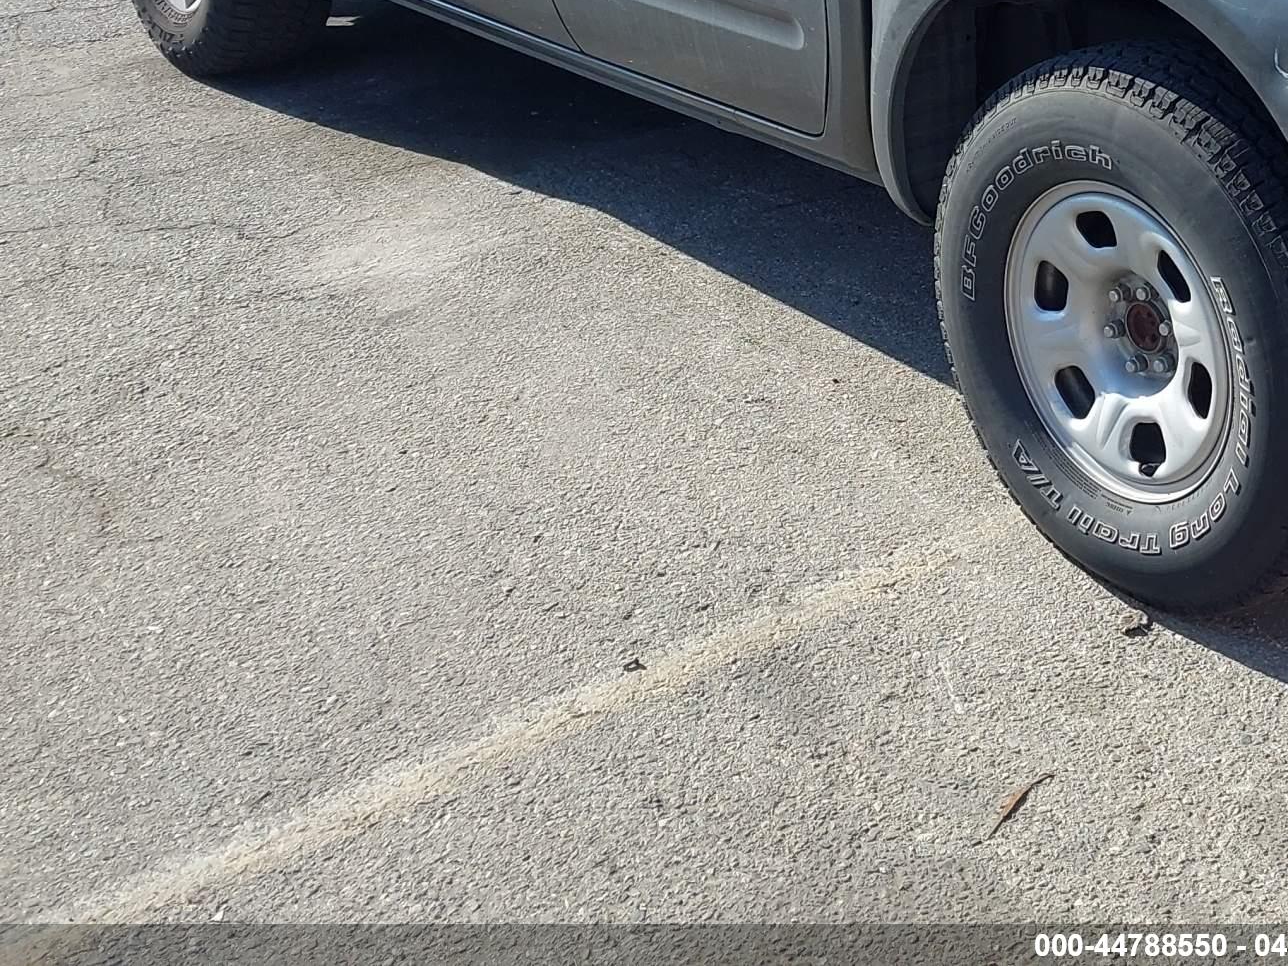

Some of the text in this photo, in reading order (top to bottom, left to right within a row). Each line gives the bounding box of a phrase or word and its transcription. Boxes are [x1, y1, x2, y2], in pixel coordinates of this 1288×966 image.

[1210, 275, 1257, 467] Radial
[1011, 438, 1064, 512] T/A
[1168, 466, 1241, 549] Long
[1067, 503, 1162, 555] Trail
